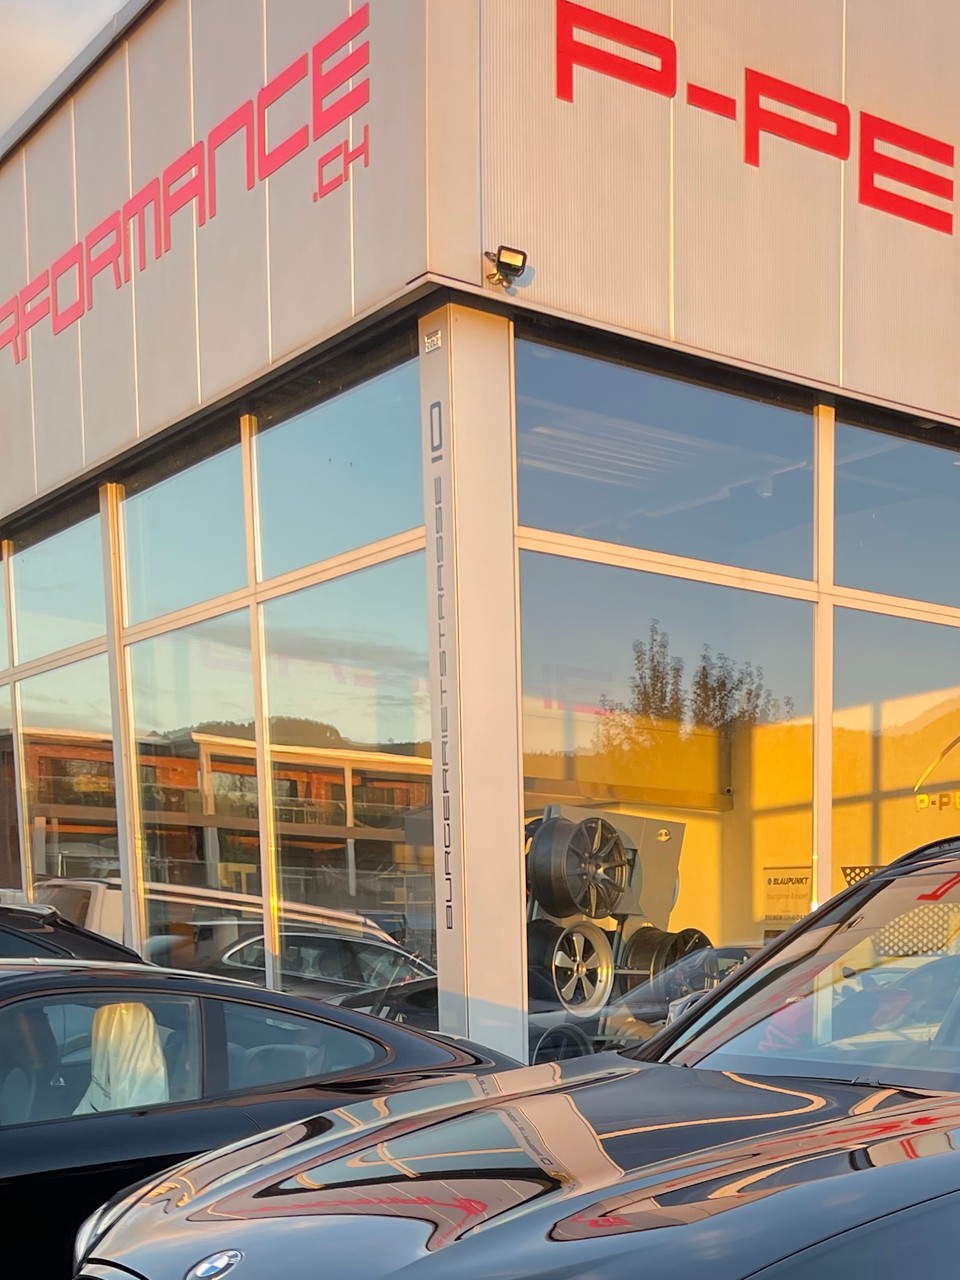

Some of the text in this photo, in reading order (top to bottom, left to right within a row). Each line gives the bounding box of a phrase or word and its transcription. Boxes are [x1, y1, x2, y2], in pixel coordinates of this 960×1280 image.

[313, 124, 370, 203] .CH
[429, 400, 453, 929] BURGERRIETSTRASSE 10
